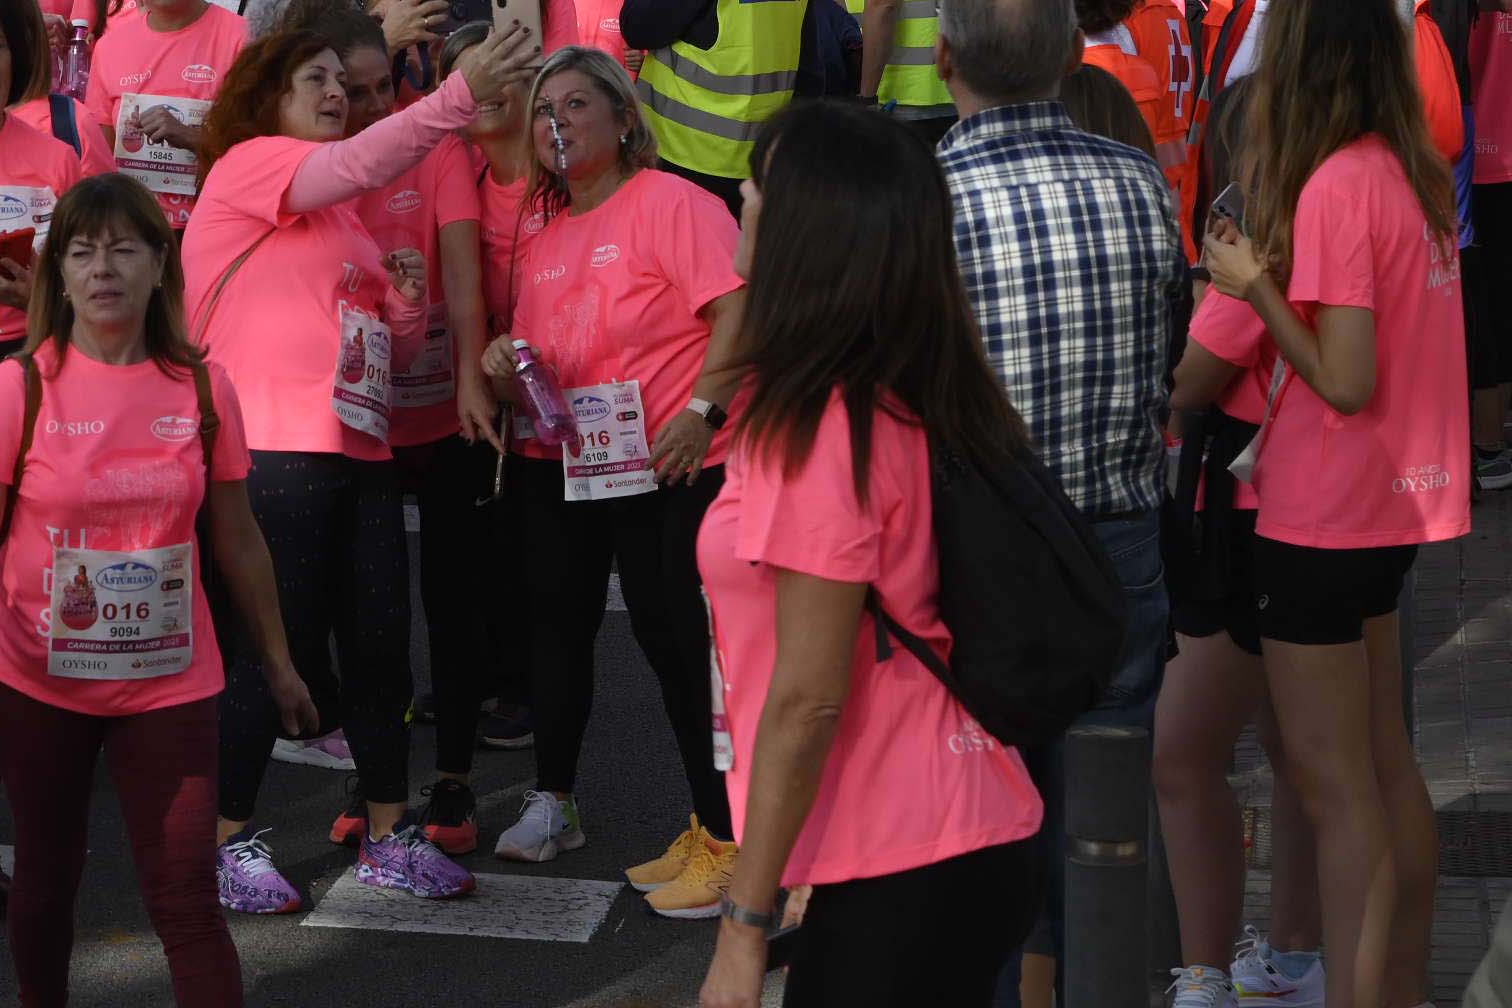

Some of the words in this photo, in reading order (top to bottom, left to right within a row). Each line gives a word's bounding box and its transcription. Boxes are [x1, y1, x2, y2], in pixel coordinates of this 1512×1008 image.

[148, 150, 173, 161] 15845
[613, 478, 647, 488] Santander
[1392, 472, 1450, 493] OYSHO
[101, 573, 153, 585] ASTURIANA
[102, 602, 150, 621] 016
[109, 626, 141, 638] 9094
[67, 641, 107, 651] CARRERA
[108, 643, 121, 651] DE
[62, 659, 108, 671] OYSHO
